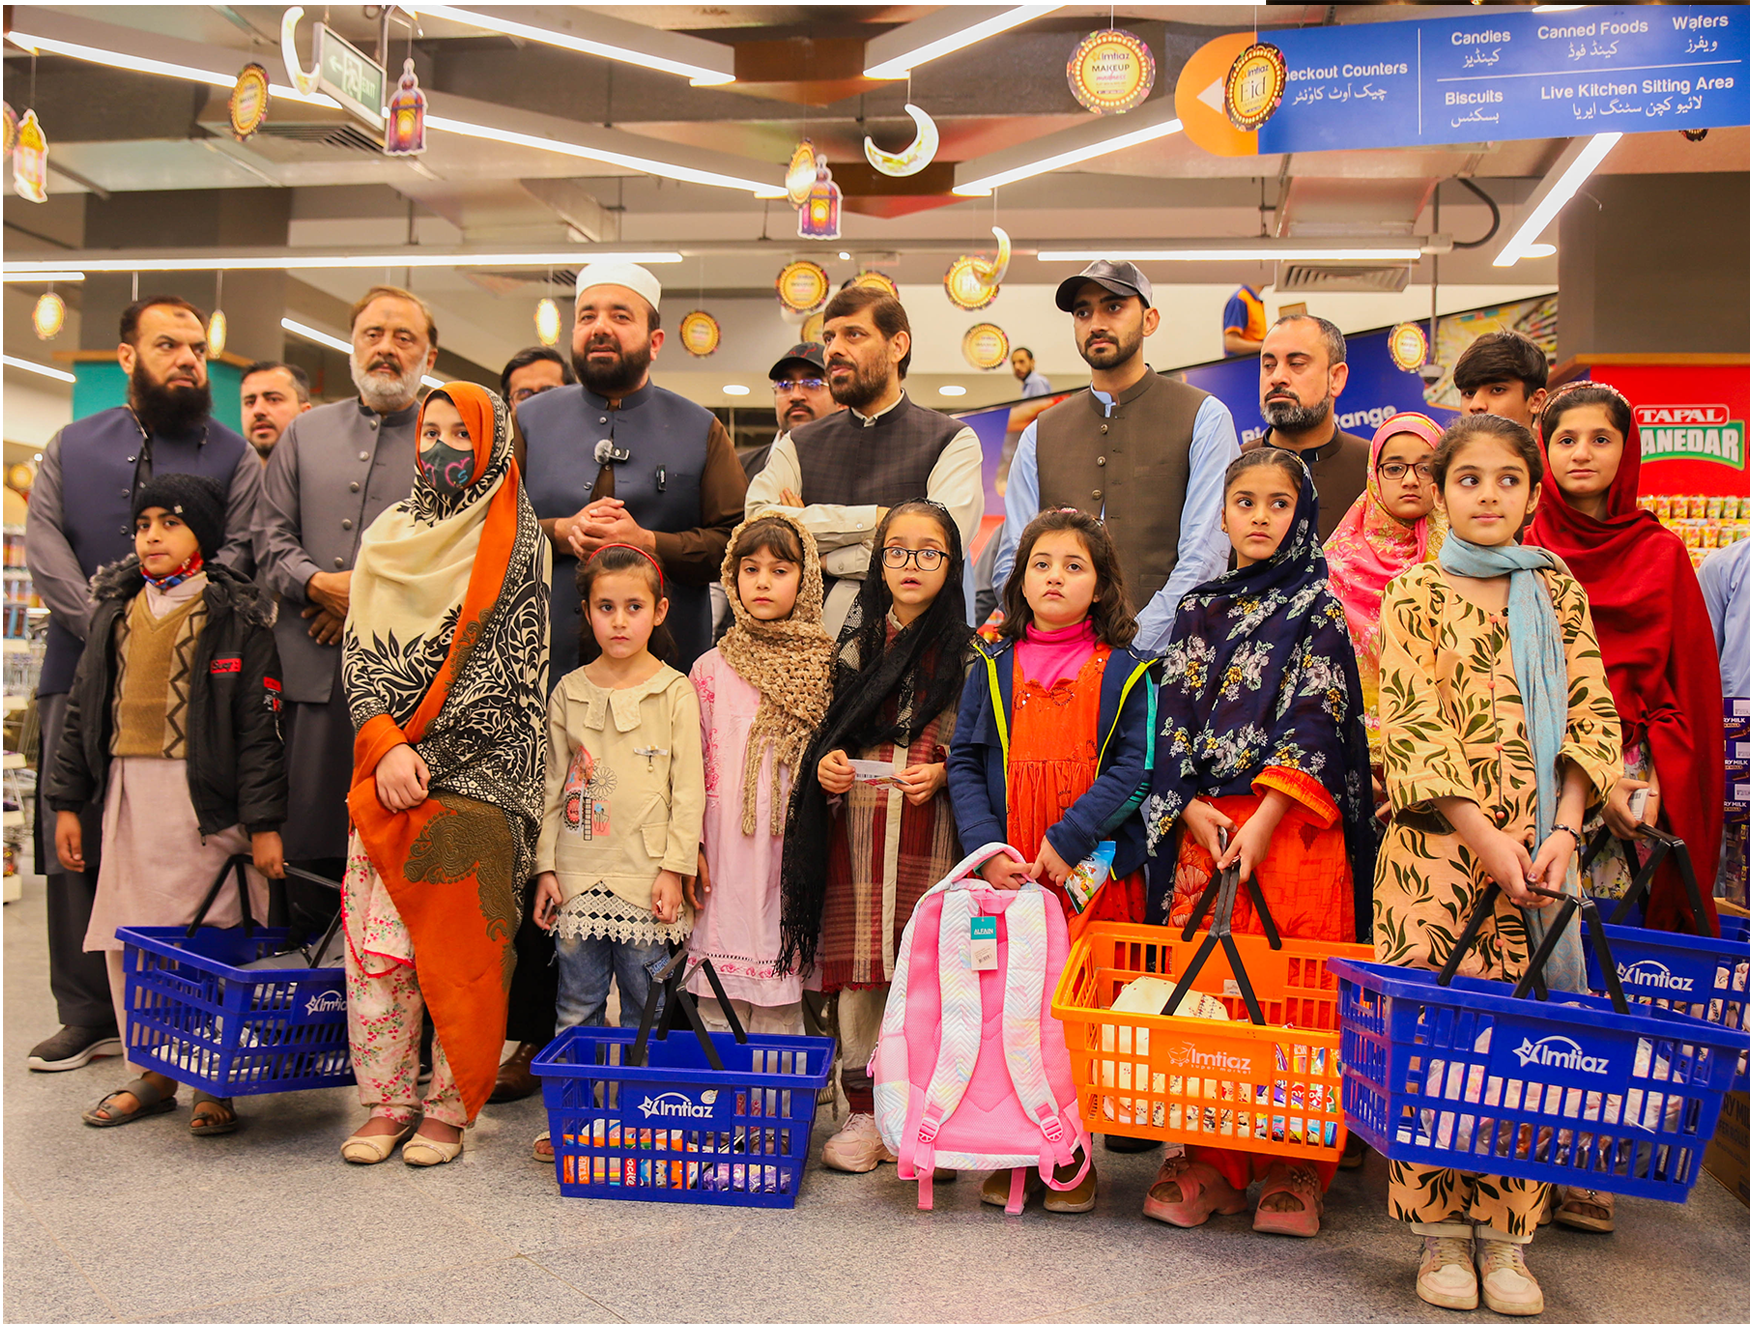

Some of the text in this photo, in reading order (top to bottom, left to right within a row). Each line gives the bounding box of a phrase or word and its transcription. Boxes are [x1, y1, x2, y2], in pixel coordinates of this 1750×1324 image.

[1537, 19, 1649, 40] Canned Foods
[1672, 14, 1730, 30] Wafers
[1451, 29, 1512, 46] Candies
[1091, 64, 1131, 73] MAKEUP
[1342, 62, 1409, 79] Counters
[1239, 76, 1267, 103] Eid
[1444, 89, 1504, 106] Biscuits
[1540, 76, 1735, 100] Live Kitchen Sitting Area
[1637, 408, 1725, 423] TAPAL
[1641, 428, 1739, 464] ANEDAR
[1633, 967, 1695, 992] Imtiaz
[319, 997, 347, 1012] Imtia
[1191, 1048, 1251, 1071] Imtiaz
[1540, 1044, 1610, 1075] Imtiaz
[660, 1100, 714, 1119] Imtiaz
